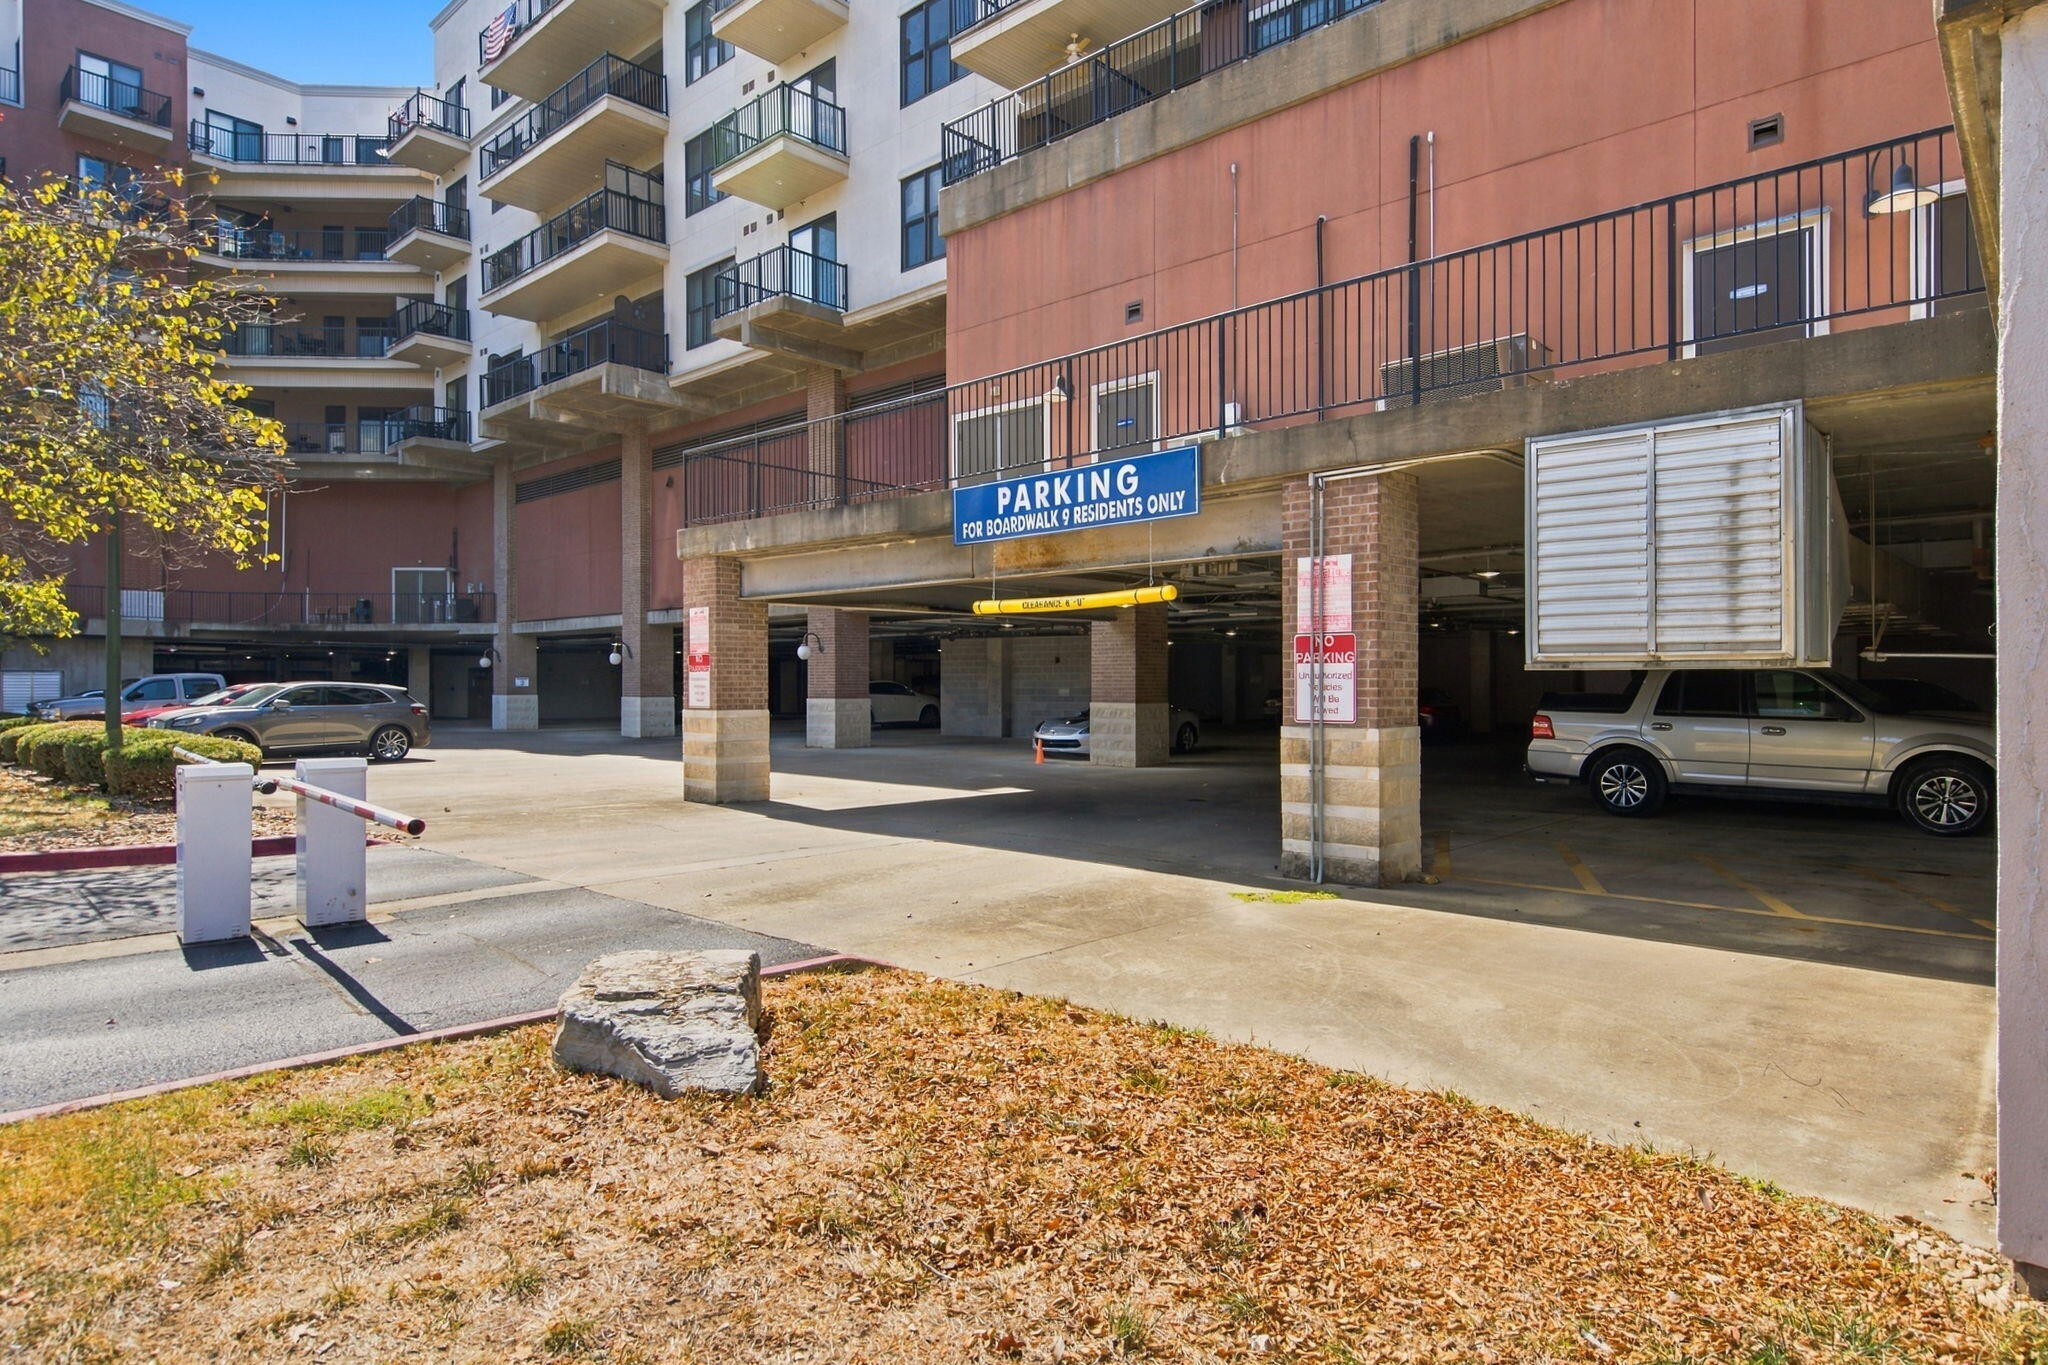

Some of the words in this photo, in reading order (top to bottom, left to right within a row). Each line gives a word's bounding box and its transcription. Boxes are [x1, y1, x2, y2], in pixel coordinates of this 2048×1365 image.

[998, 464, 1138, 514] PARKING
[962, 521, 983, 539] FOR
[986, 509, 1059, 536] BOARDWALK
[1062, 508, 1070, 526] 9
[1073, 496, 1143, 524] RESIDENTS
[1147, 490, 1186, 514] ONLY
[1315, 635, 1334, 647] NO
[1296, 651, 1355, 663] PARKING
[1298, 671, 1353, 680] Unuhorized
